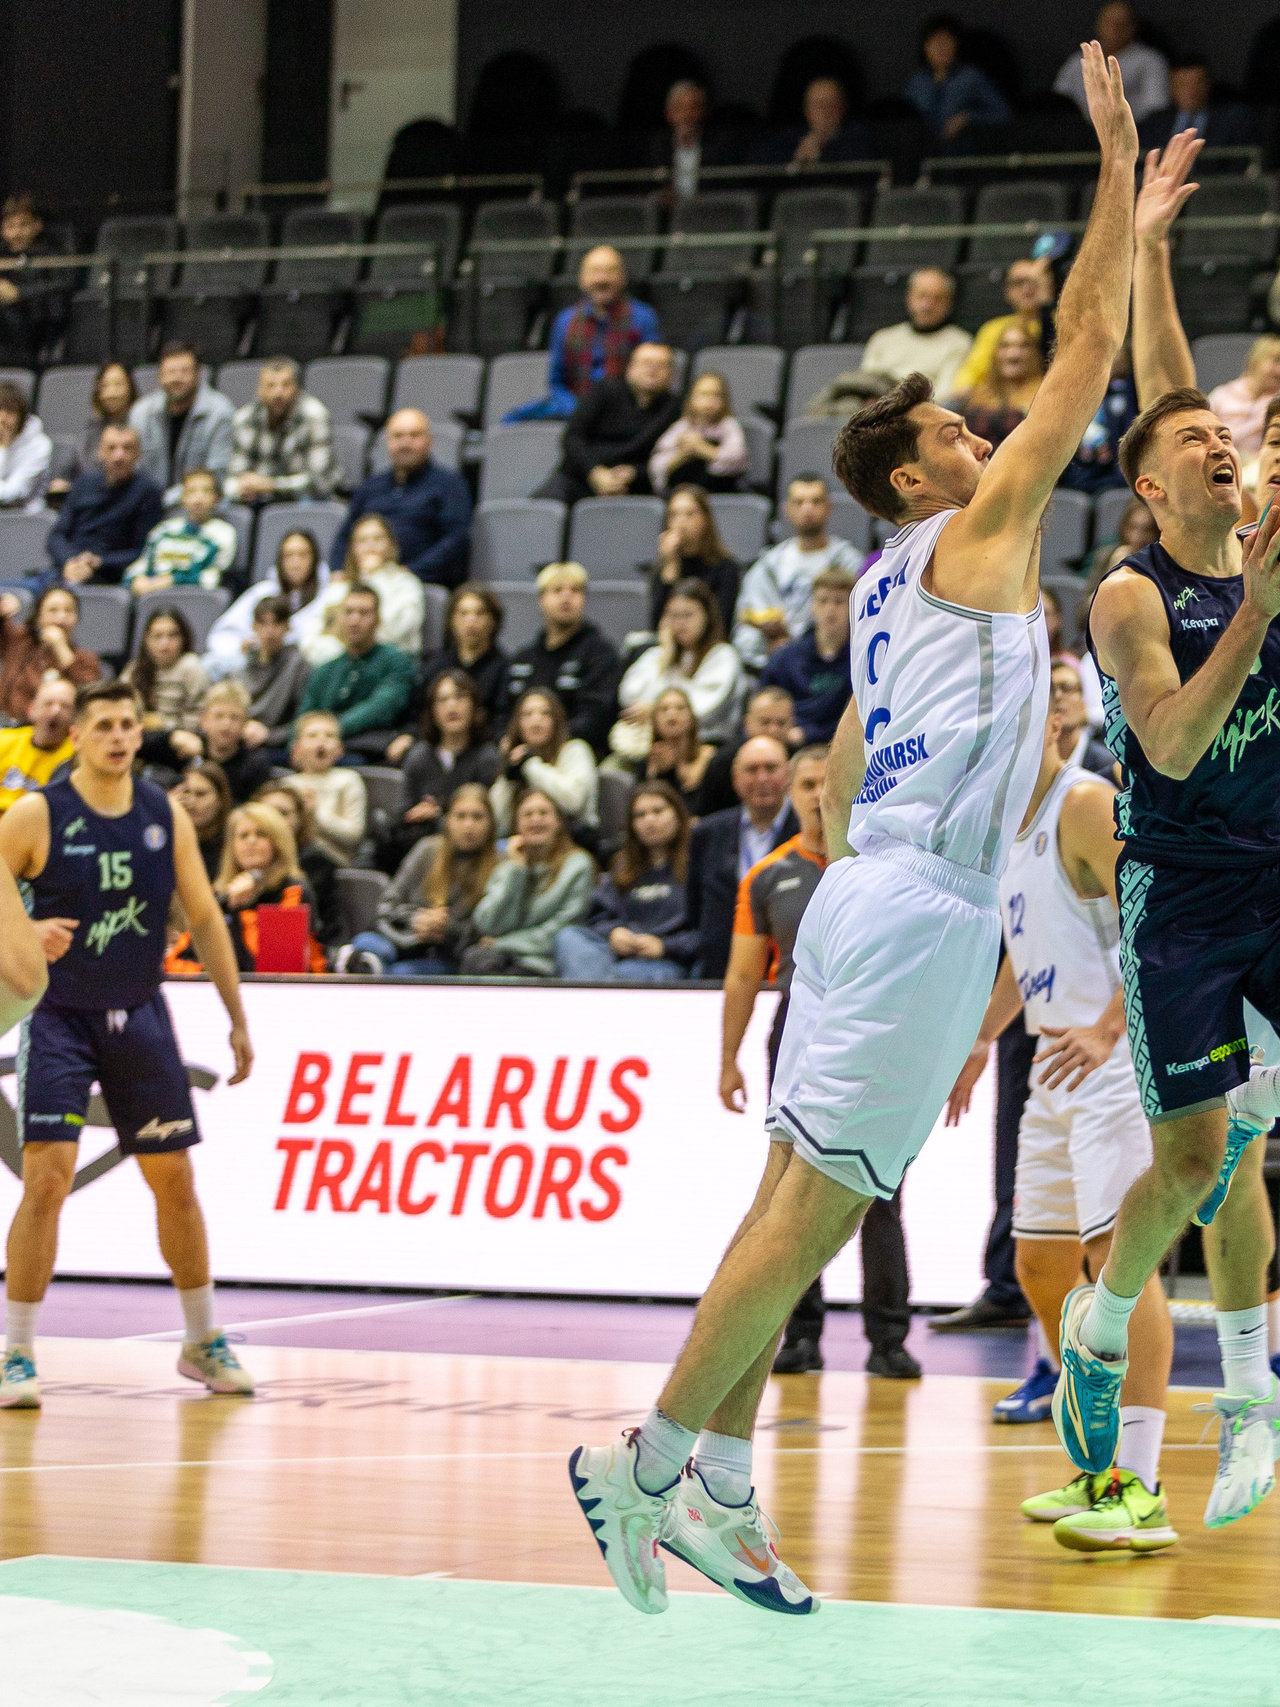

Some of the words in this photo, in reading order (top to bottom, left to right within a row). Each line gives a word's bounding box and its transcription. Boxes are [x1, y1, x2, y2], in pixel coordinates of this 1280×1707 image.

[1181, 617, 1219, 631] Kempa
[98, 851, 134, 891] 15
[1166, 1056, 1210, 1076] Kempa
[282, 1051, 650, 1134] BELARUS
[274, 1137, 630, 1222] TRACTORS
